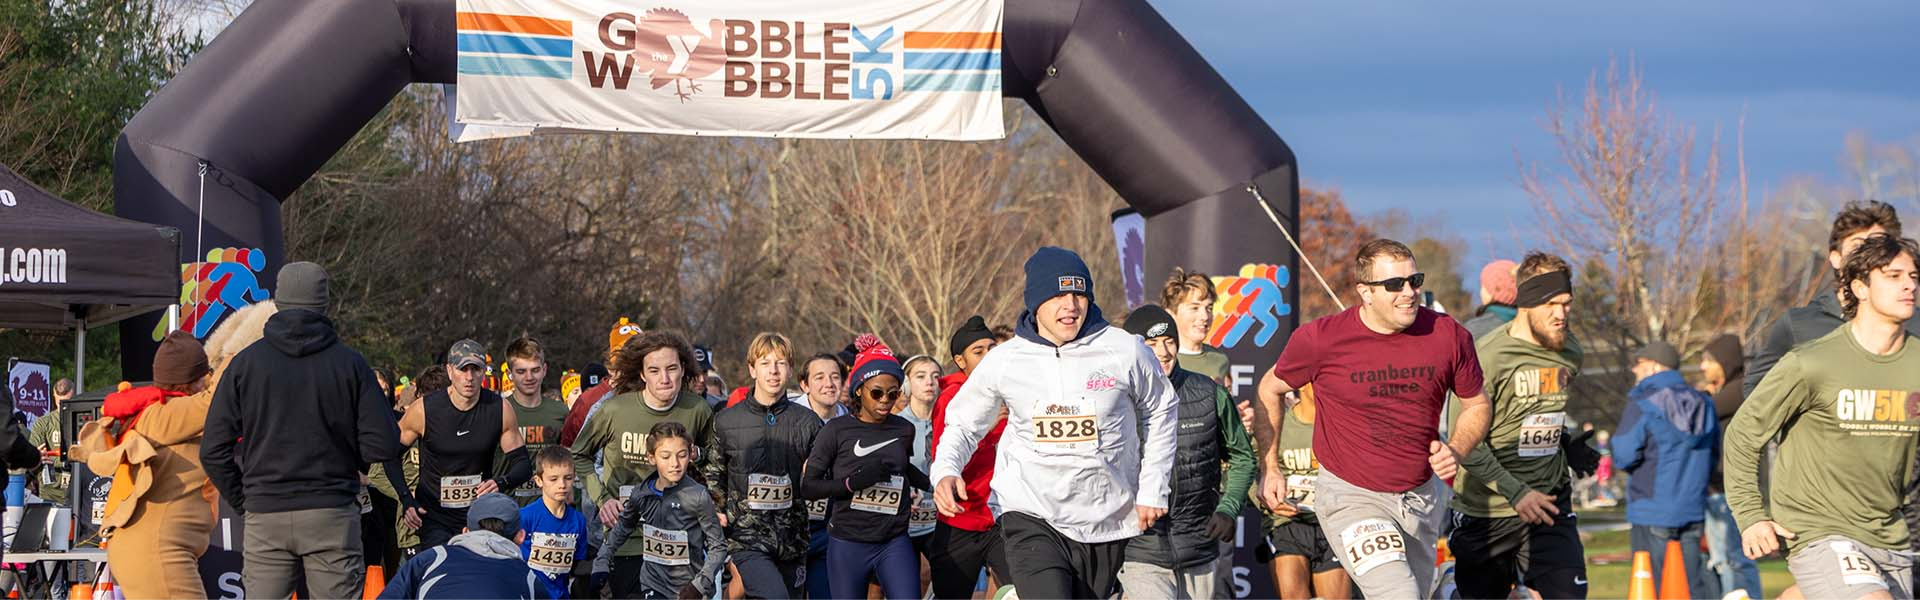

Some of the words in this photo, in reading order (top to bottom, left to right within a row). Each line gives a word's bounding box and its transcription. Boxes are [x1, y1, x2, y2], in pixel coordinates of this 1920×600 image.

[852, 25, 894, 100] 5K
[1350, 364, 1435, 384] cranberry
[1515, 367, 1559, 397] GW5K
[19, 387, 46, 401] 9-11
[1369, 382, 1420, 397] sauce
[1837, 389, 1907, 421] GW5K
[1036, 419, 1096, 438] 1828
[621, 432, 649, 455] GW
[1521, 429, 1561, 445] 1649
[442, 487, 478, 500] 1839
[749, 487, 792, 500] 4719
[856, 489, 900, 504] 1479
[806, 501, 826, 513] 45
[911, 510, 936, 521] 823
[645, 540, 687, 556] 1437
[1349, 534, 1403, 563] 1685
[531, 549, 573, 564] 1436
[1843, 556, 1879, 573] 15
